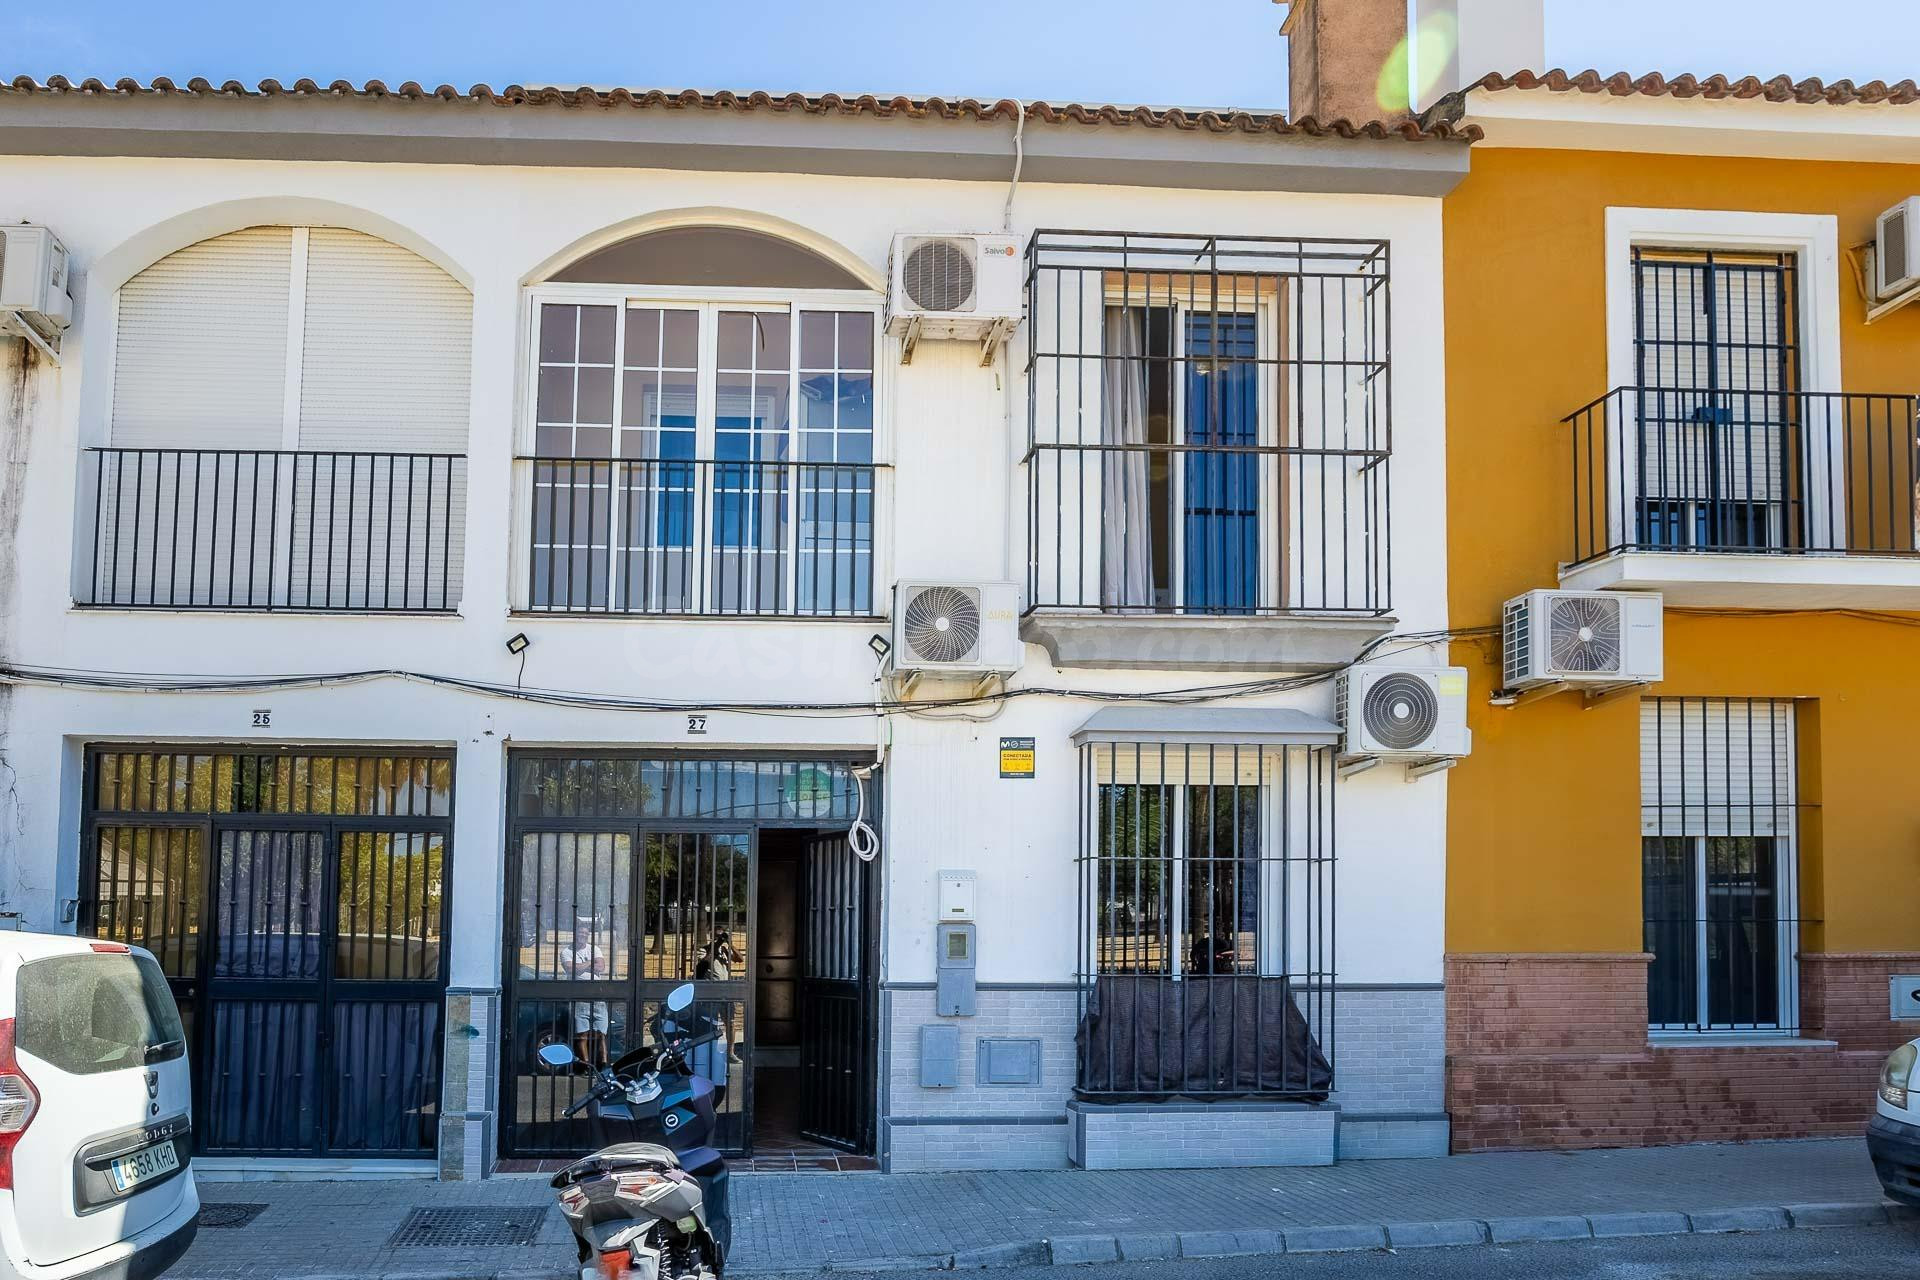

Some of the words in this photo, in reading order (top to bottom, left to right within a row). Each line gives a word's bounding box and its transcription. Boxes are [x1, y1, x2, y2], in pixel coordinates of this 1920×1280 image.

[253, 713, 270, 725] 25
[688, 719, 706, 730] 27
[123, 1152, 154, 1181] 4658
